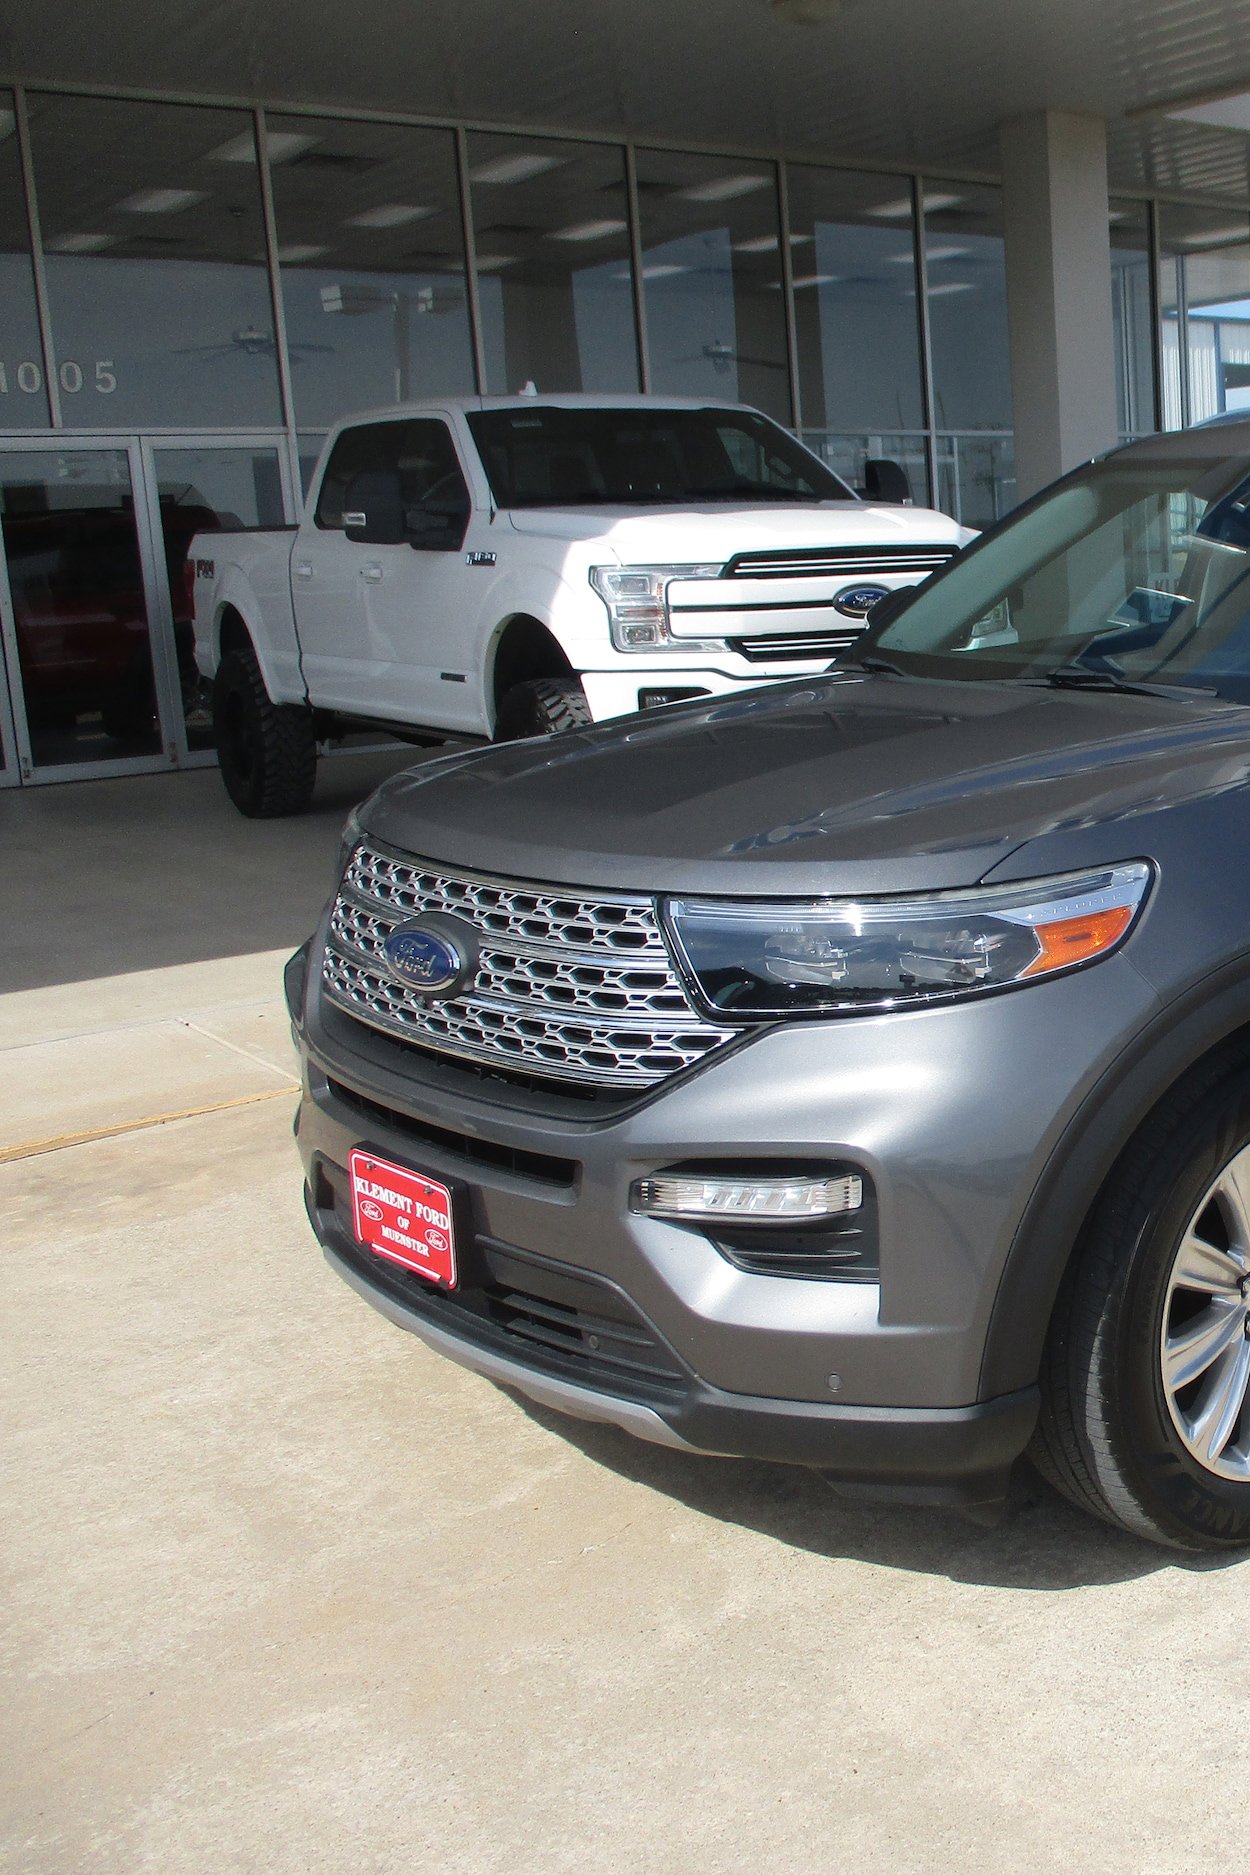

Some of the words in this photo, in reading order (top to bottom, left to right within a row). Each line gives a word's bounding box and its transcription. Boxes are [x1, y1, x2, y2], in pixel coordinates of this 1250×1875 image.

[393, 936, 437, 979] Ford
[355, 1177, 413, 1213] KLEMENT
[415, 1201, 449, 1231] FORD
[381, 1225, 430, 1257] MUENSTER
[397, 1216, 411, 1231] OF
